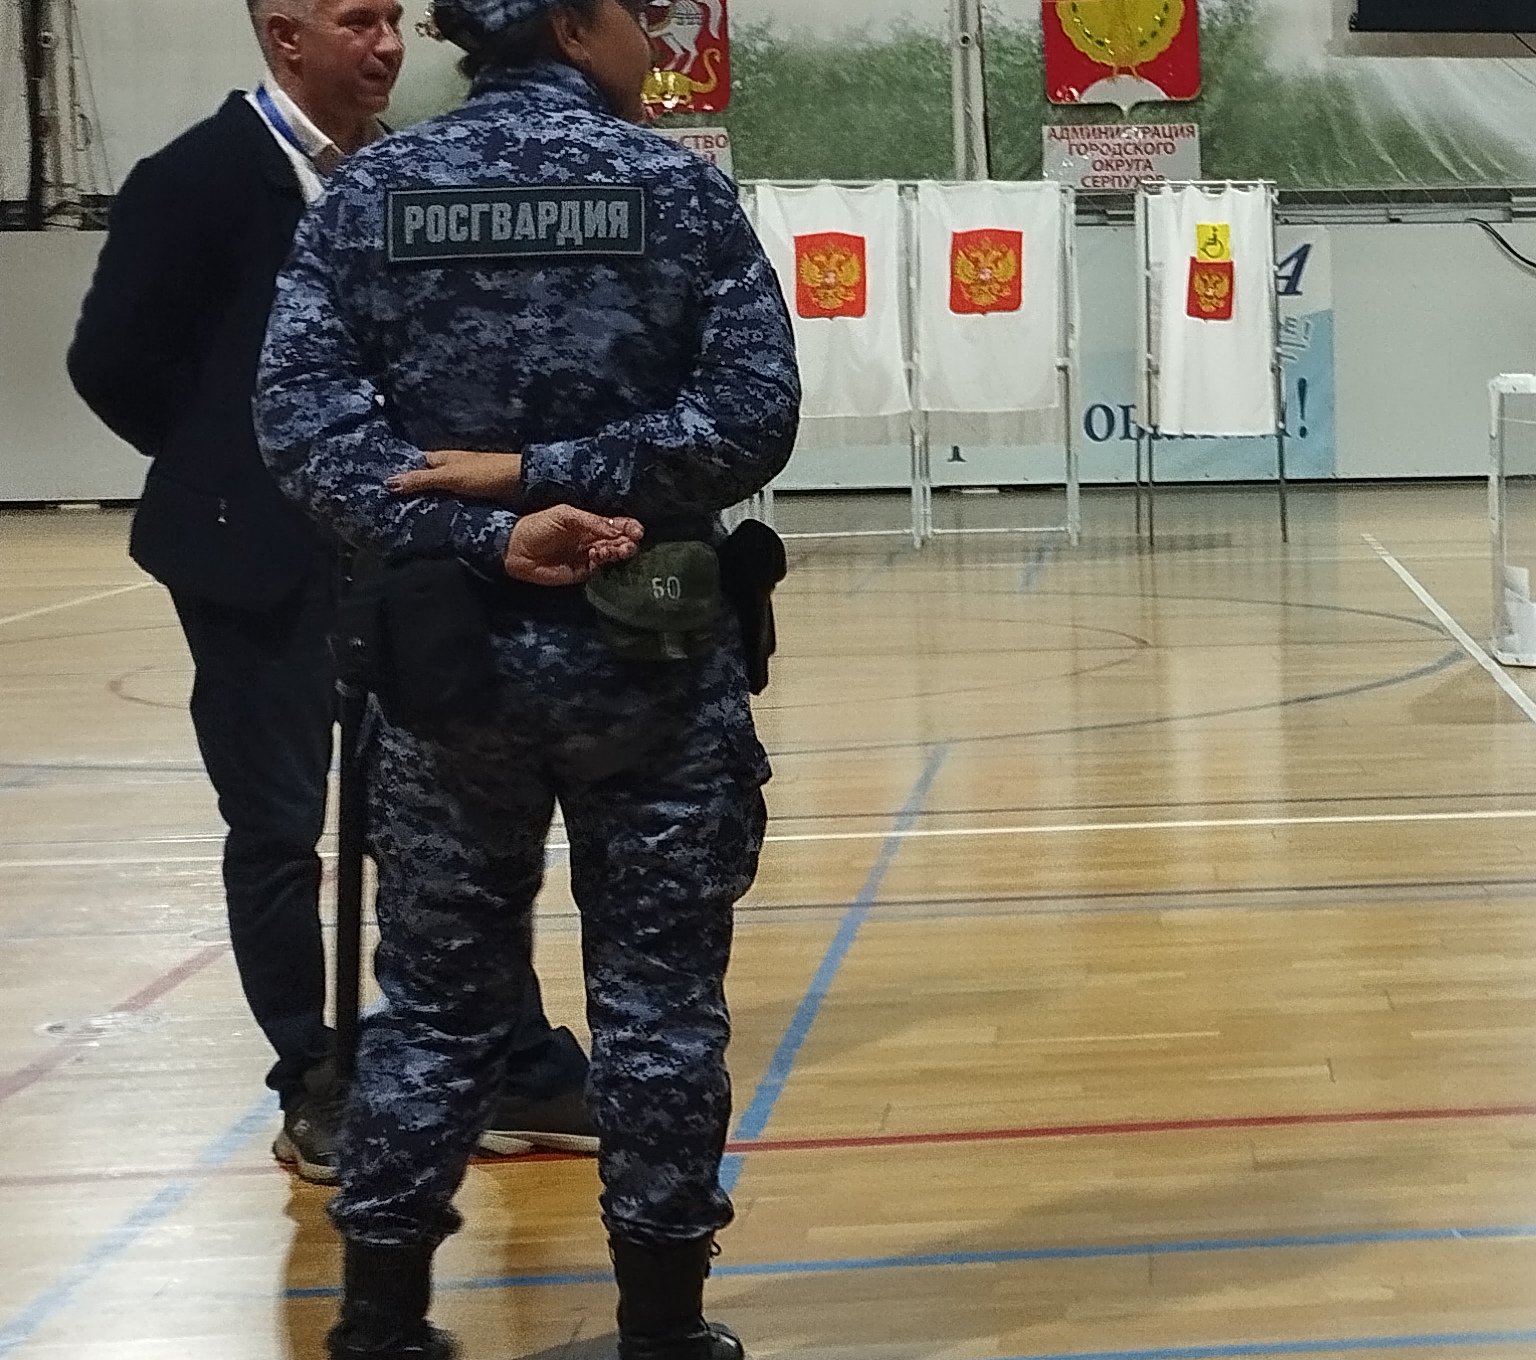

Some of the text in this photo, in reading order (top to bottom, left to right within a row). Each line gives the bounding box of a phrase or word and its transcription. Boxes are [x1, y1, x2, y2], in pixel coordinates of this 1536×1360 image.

[1068, 141, 1177, 158] ГОРОДСКОГО
[1092, 158, 1156, 173] ОКРУГА
[404, 200, 629, 245] РОСГВАРДИЯ
